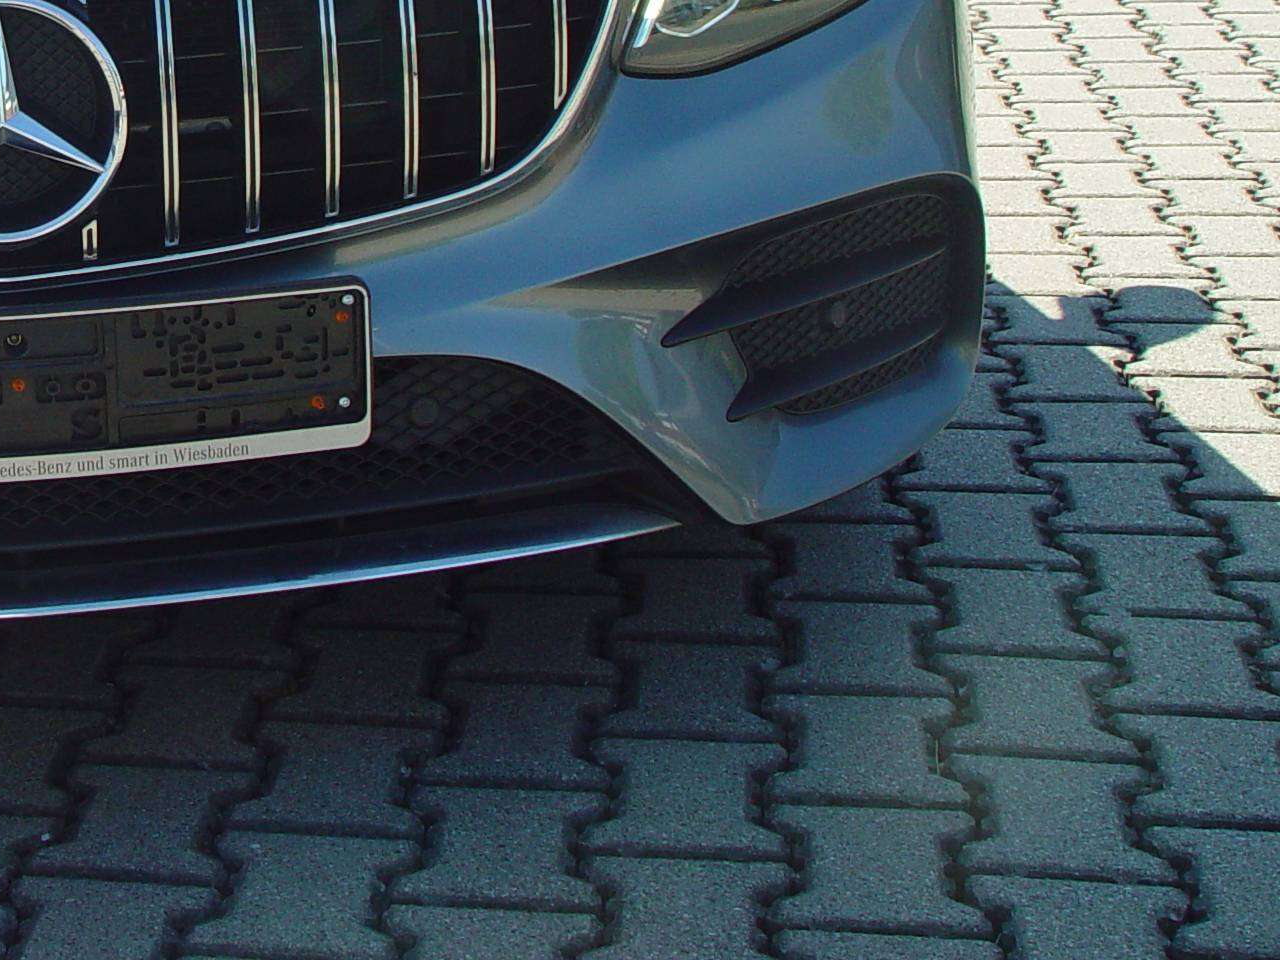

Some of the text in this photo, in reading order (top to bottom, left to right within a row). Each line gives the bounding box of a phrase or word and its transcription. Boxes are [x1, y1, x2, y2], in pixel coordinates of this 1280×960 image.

[77, 455, 104, 473] und
[108, 452, 150, 469] smart
[154, 450, 168, 466] in
[173, 442, 250, 463] Wiesbaden
